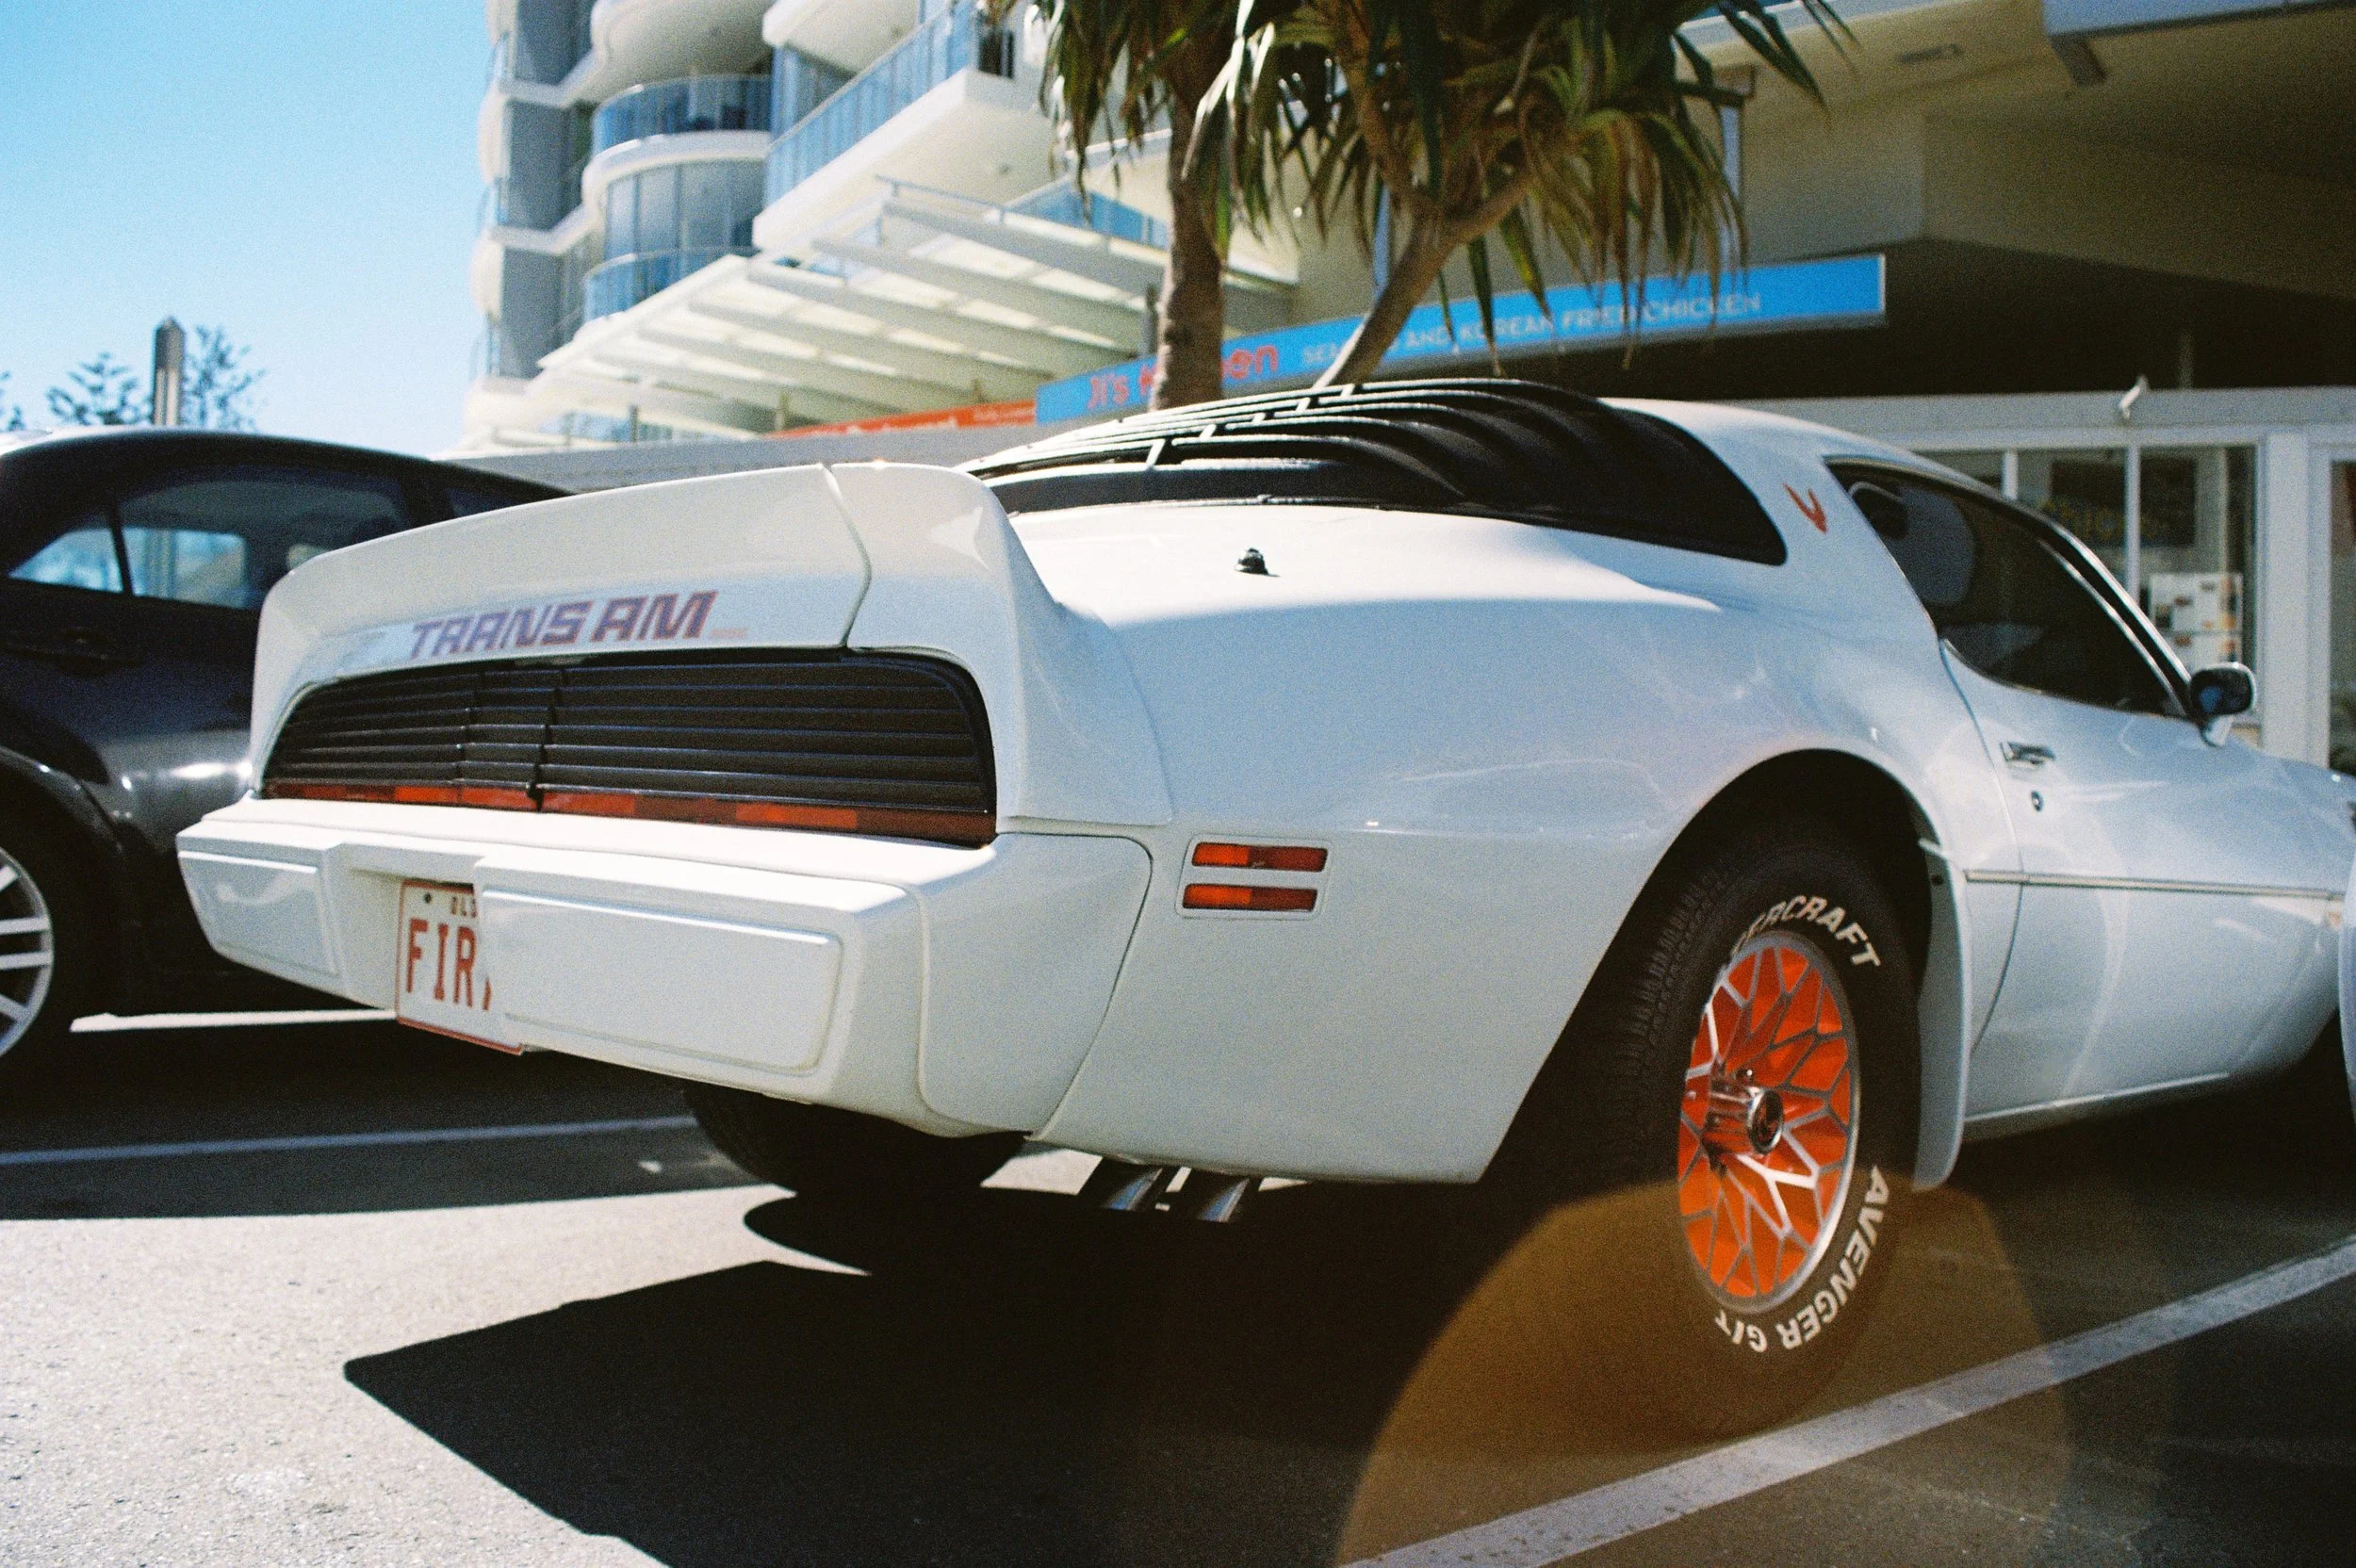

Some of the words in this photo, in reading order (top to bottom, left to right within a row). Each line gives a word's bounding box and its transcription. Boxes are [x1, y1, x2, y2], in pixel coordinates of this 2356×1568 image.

[410, 600, 594, 660] TRANS
[589, 590, 719, 643] AM
[1730, 894, 1881, 967] ERCRAFT
[1775, 1165, 1890, 1349] AVENGER
